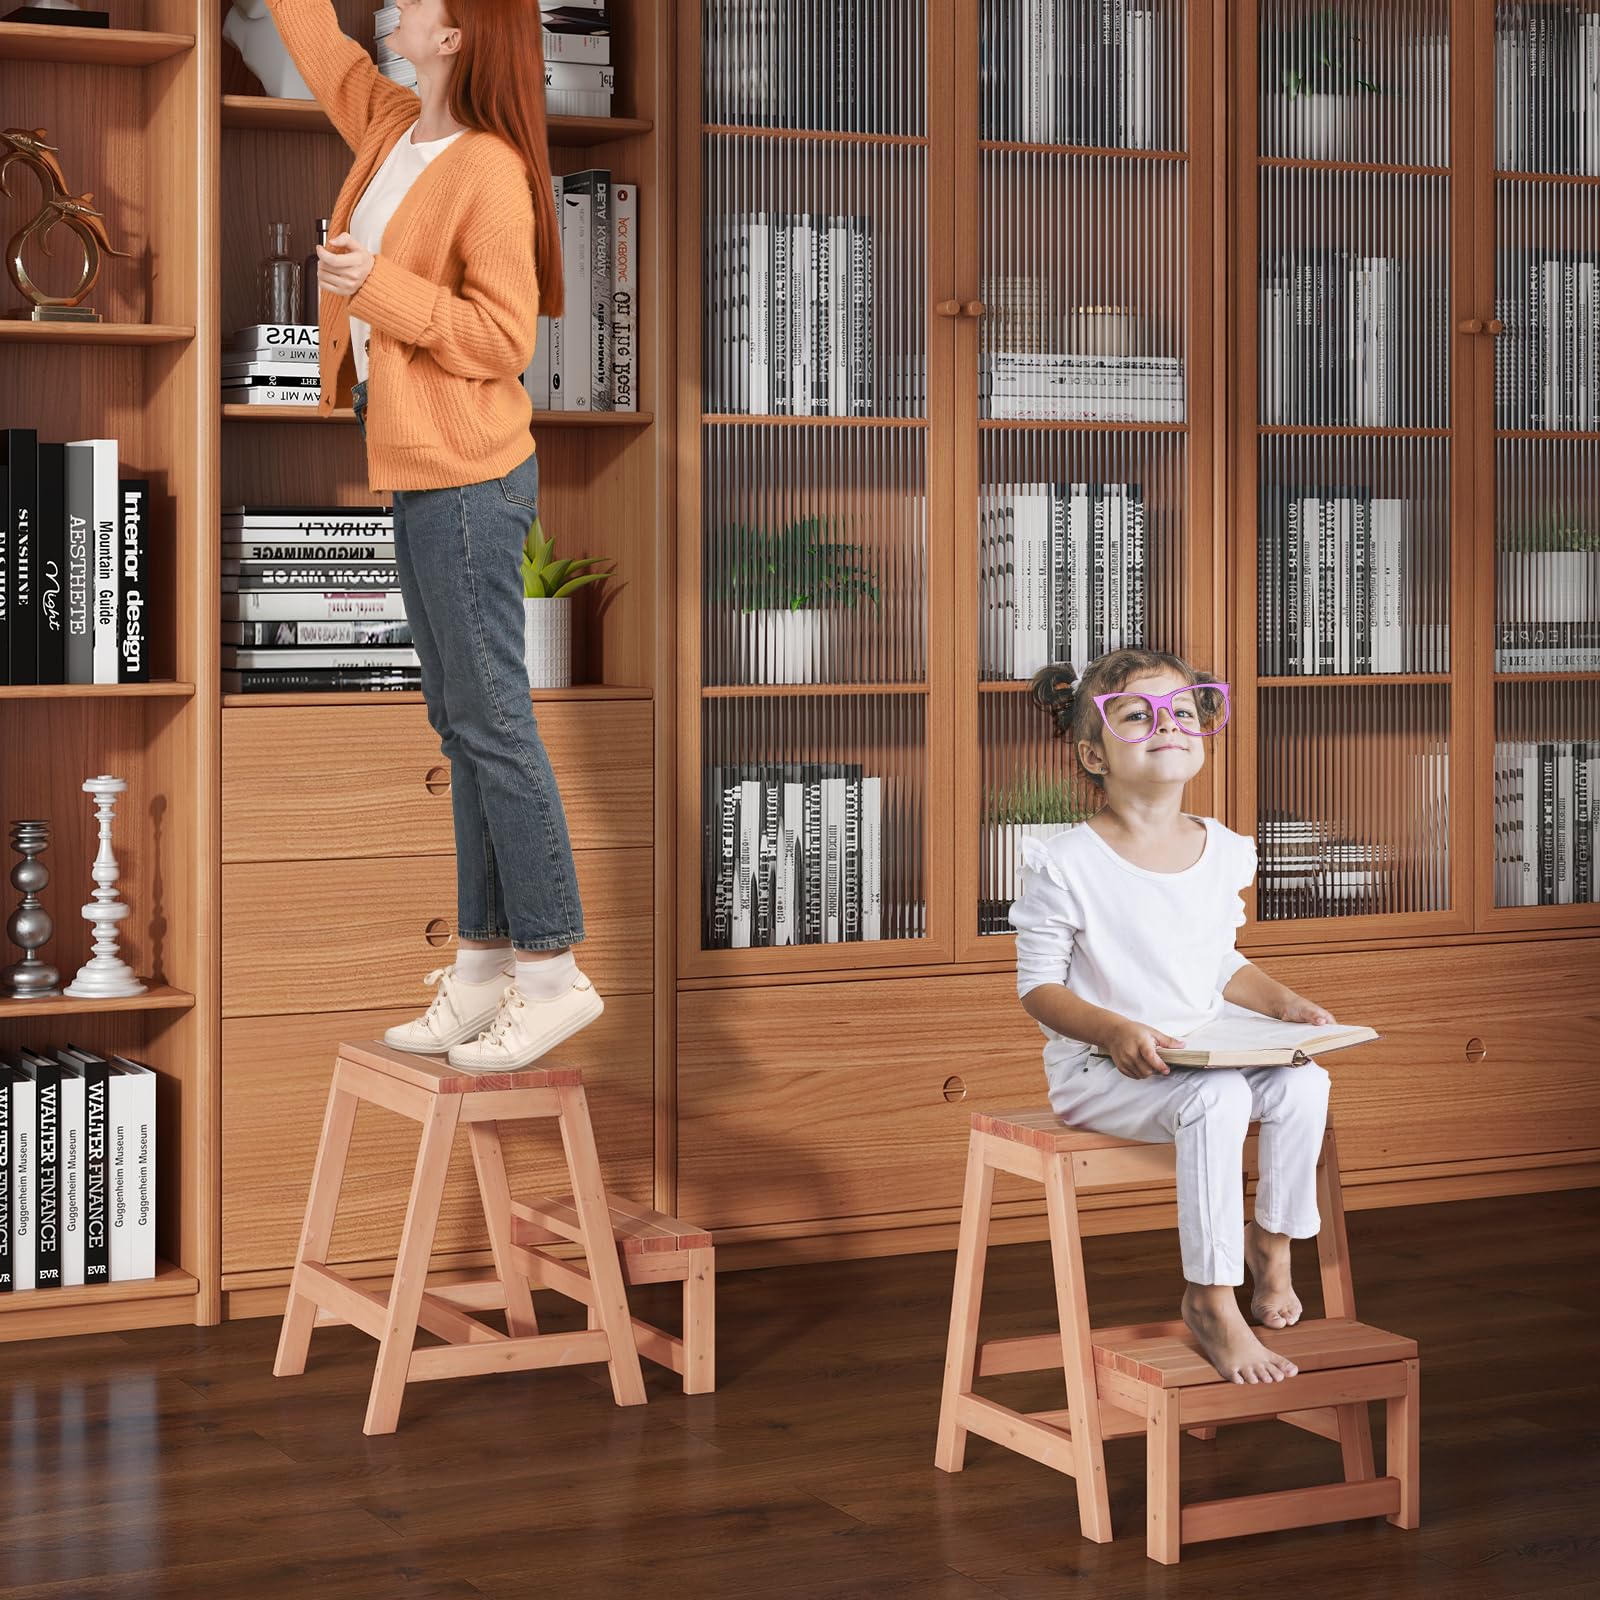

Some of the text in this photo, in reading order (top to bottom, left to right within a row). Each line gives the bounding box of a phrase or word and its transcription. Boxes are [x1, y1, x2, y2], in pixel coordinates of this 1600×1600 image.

[18, 508, 29, 606] SUNSHINE
[69, 514, 87, 635] AESTHETE
[99, 521, 114, 625] Mountain Guide
[123, 491, 145, 672] Interior design
[18, 1132, 30, 1236] Guggenheim Museum
[40, 1083, 57, 1252] WALTER FINANCE
[67, 1129, 79, 1232] Guggenheim Museum
[88, 1080, 104, 1248] WALTER FINANCE
[115, 1125, 126, 1228] Guggenheim Museum
[138, 1124, 149, 1226] Guggenheim Museum
[0, 1273, 11, 1284] VR
[39, 1268, 59, 1280] EVR
[88, 1265, 106, 1275] EVR
